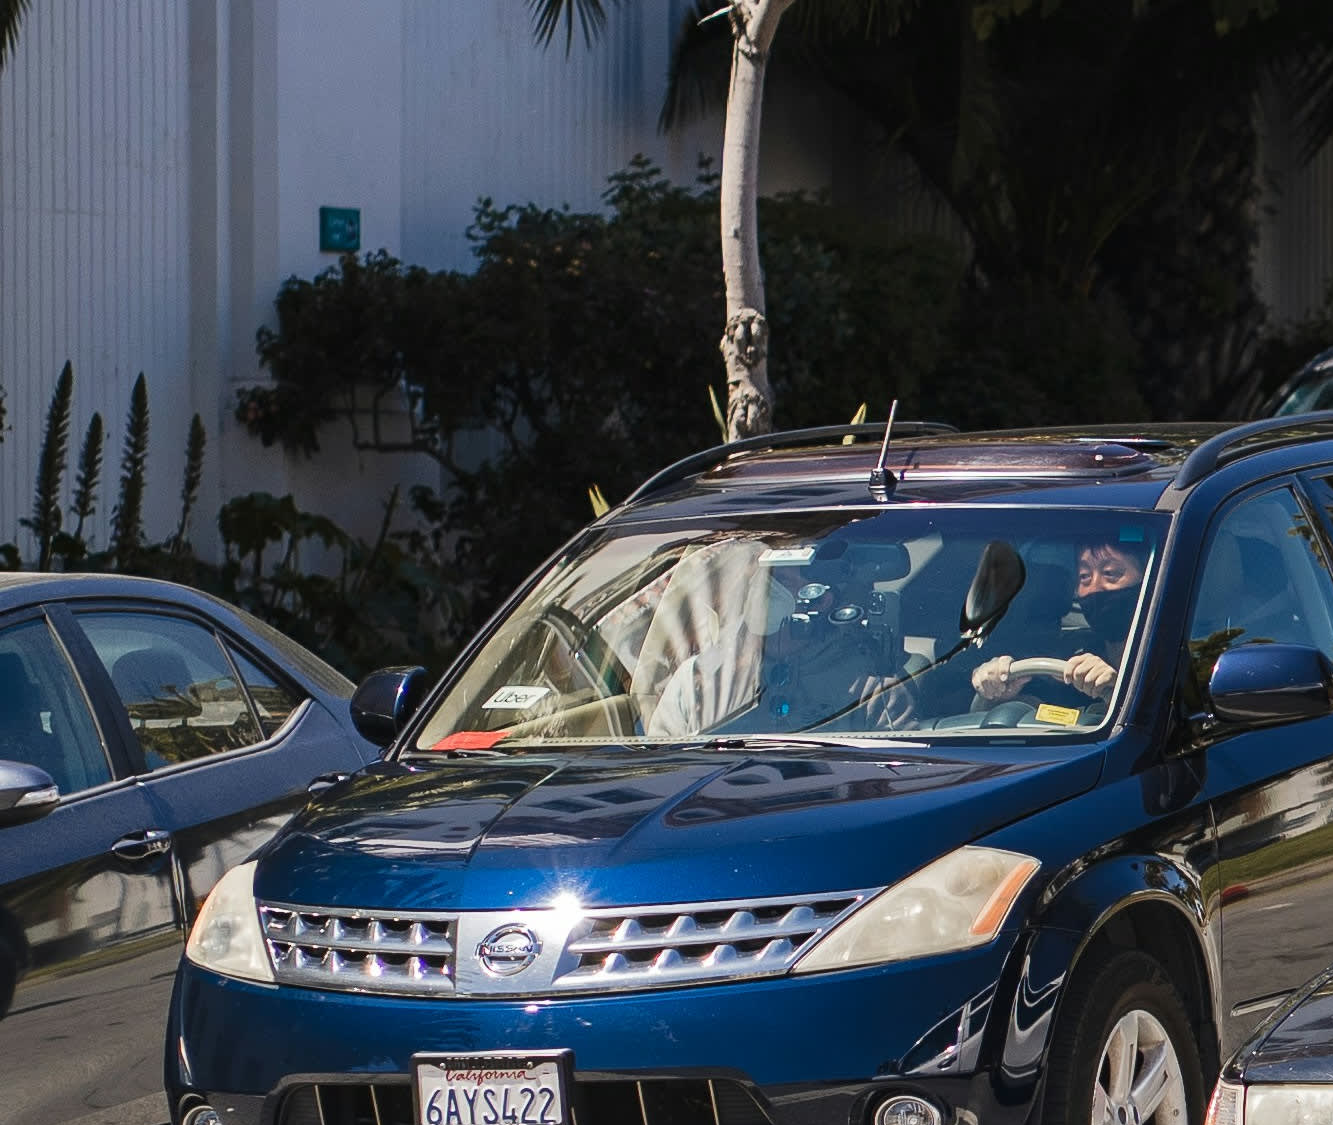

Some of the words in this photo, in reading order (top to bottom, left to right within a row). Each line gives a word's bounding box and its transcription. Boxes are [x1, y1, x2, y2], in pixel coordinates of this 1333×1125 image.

[480, 945, 534, 957] NISSAN
[446, 1069, 536, 1086] California
[426, 1087, 557, 1125] 6AYS422
